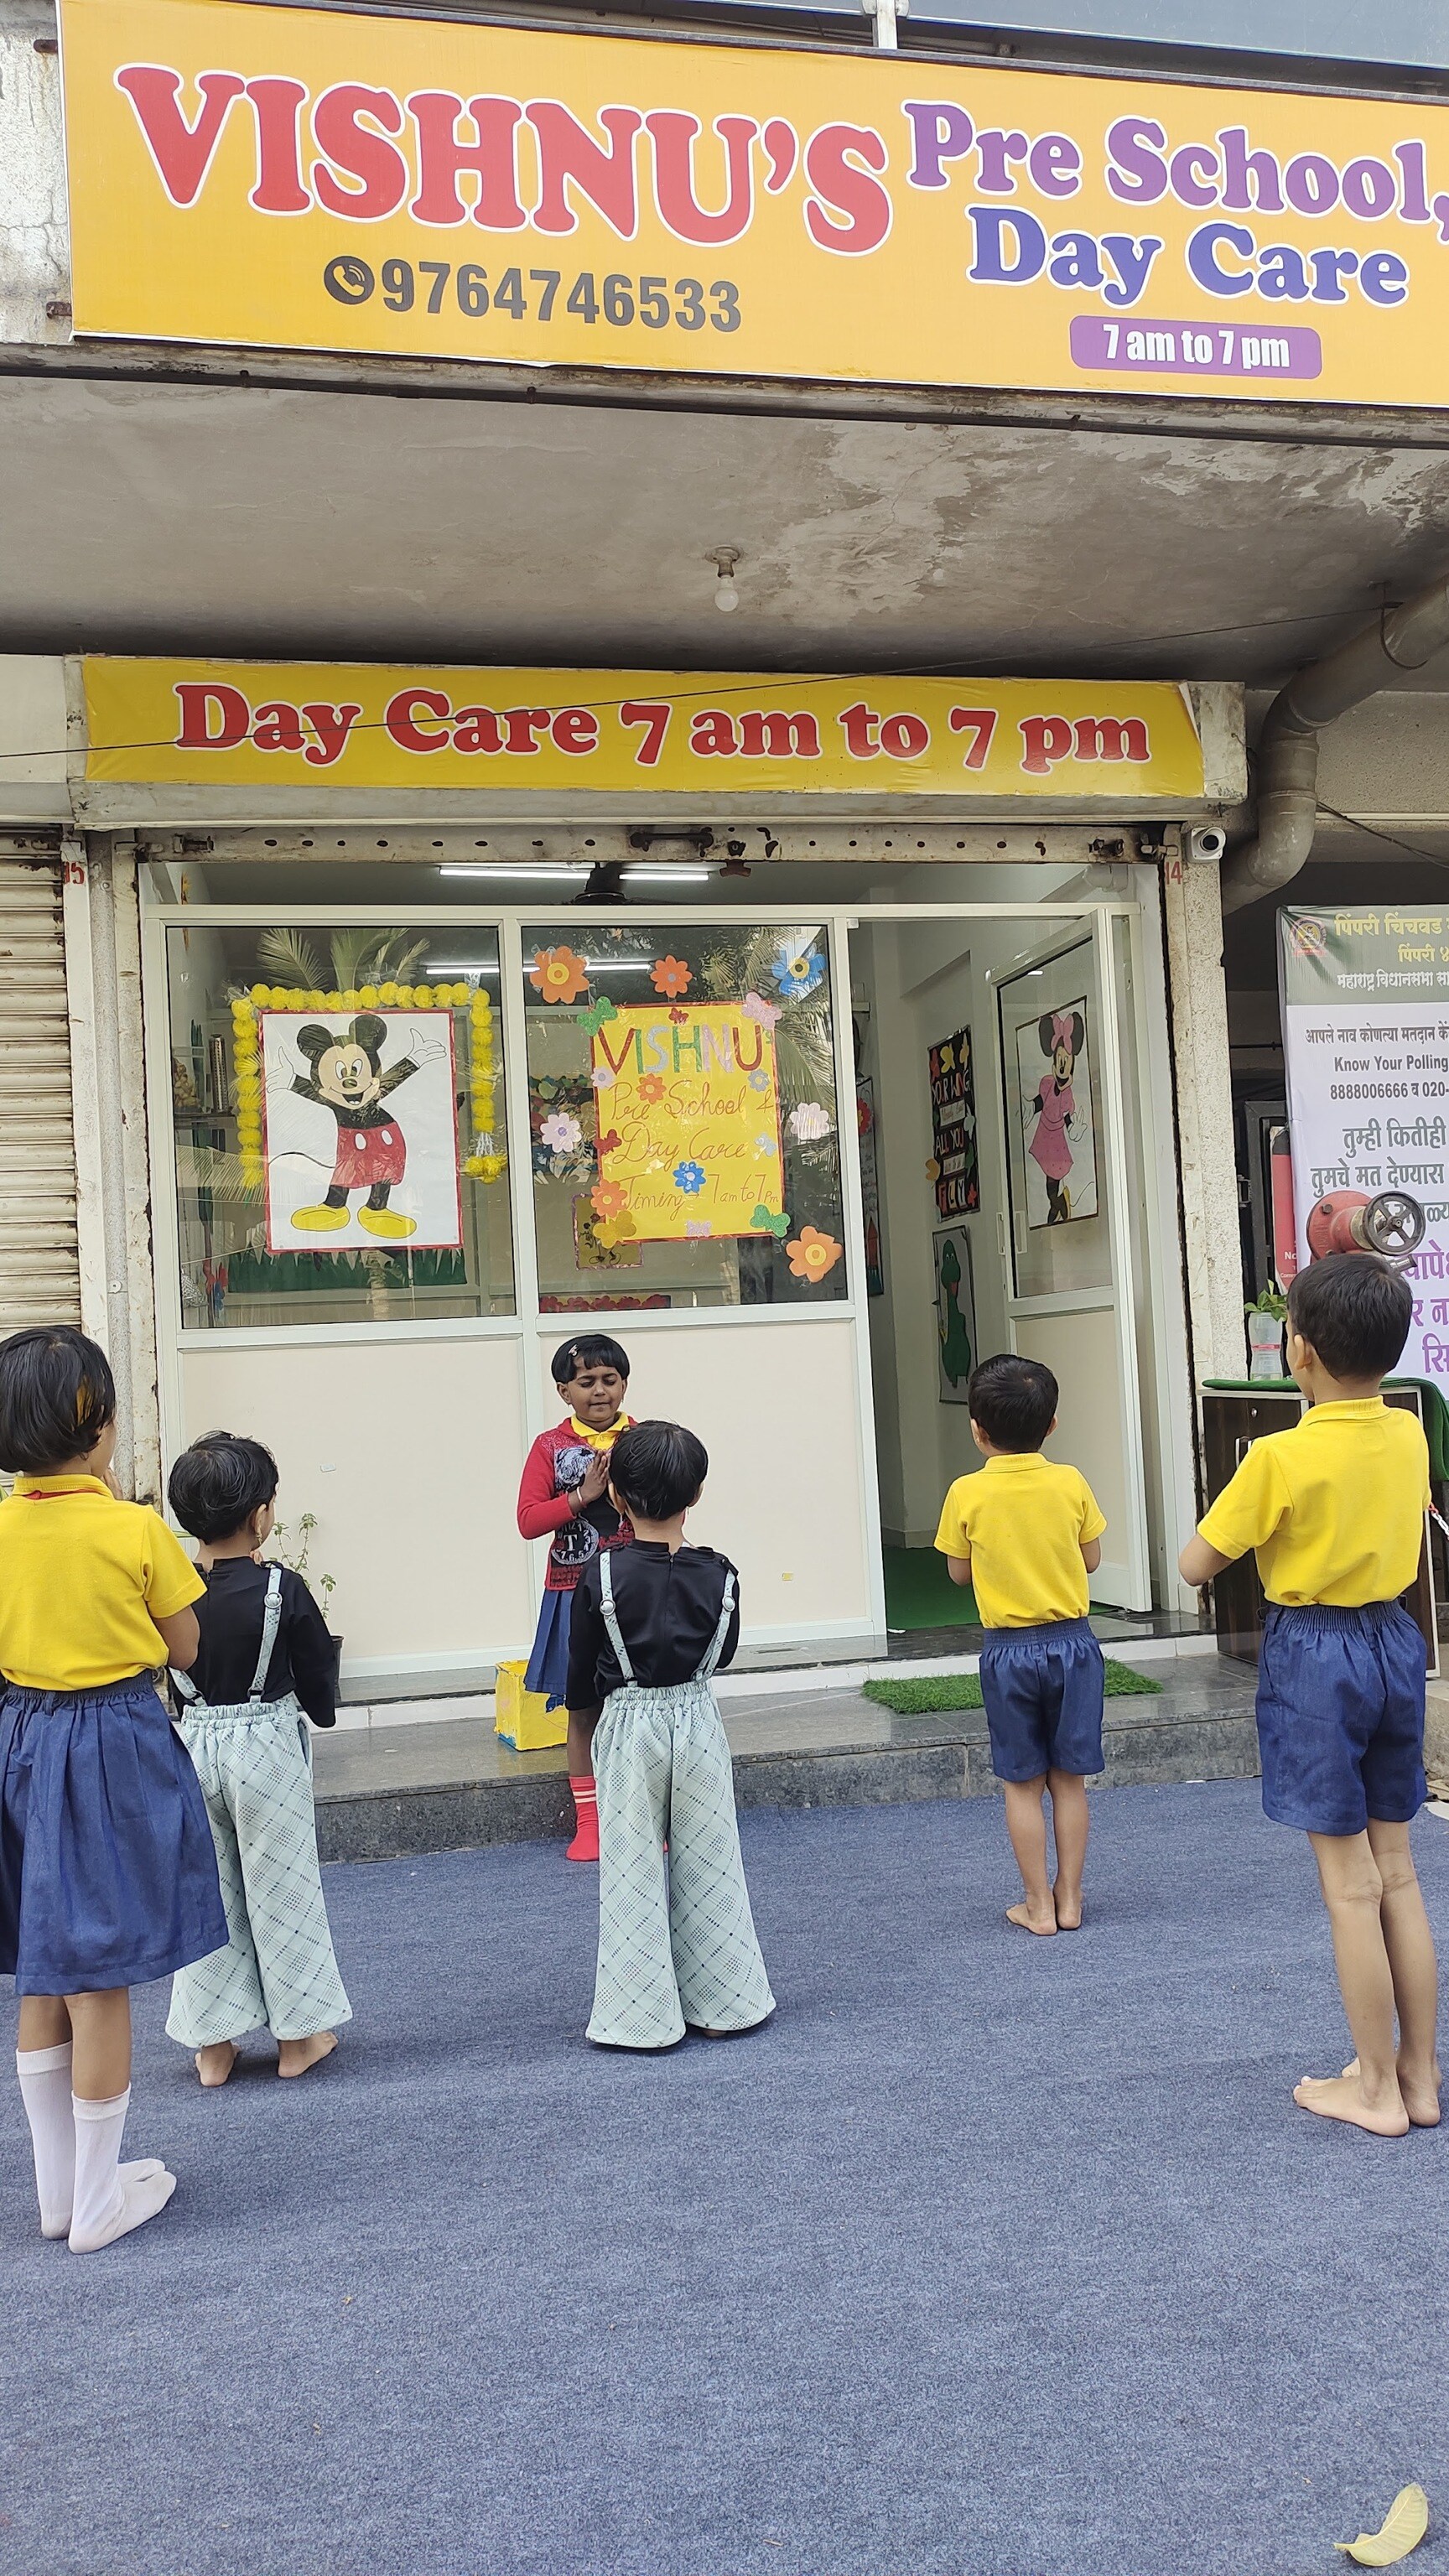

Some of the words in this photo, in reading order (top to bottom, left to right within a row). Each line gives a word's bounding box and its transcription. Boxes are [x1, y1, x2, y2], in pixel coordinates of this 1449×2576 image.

[115, 63, 892, 256] VISHNU'S
[901, 99, 1083, 199] Pre
[965, 205, 1162, 308] Day
[1186, 221, 1410, 307] Care
[382, 258, 741, 332] 9764746533
[1103, 325, 1119, 361] 7
[1126, 330, 1176, 362] am
[1182, 328, 1213, 364] to
[1218, 330, 1236, 365] 7
[1242, 336, 1291, 371] pm
[173, 682, 363, 766] Day
[384, 687, 599, 756] Care
[621, 703, 673, 766] 7
[689, 708, 823, 758] am
[839, 701, 930, 760] to
[948, 705, 999, 771] 7
[1017, 714, 1152, 774] pm
[64, 860, 85, 886] 15
[1165, 861, 1182, 885] 14
[1333, 912, 1380, 936] पिंपरी
[1384, 911, 1442, 935] चिंचवड
[1398, 943, 1435, 963] पिंपरी
[1376, 969, 1434, 988] विधानसभा
[1306, 1023, 1334, 1044] आपले
[1337, 1028, 1357, 1043] नाव
[1401, 1026, 1436, 1045] मतदान
[1334, 1056, 1370, 1072] Know
[1374, 1055, 1403, 1071] Your
[1407, 1054, 1449, 1072] Polling
[608, 1082, 650, 1120] Pre
[663, 1079, 747, 1119] School
[1330, 1082, 1409, 1100] 8888006666
[612, 1121, 680, 1171] Day
[688, 1127, 746, 1161] Care
[1342, 1117, 1382, 1158] तुम्ही
[1386, 1115, 1446, 1149] कितीही
[1310, 1158, 1350, 1198] तुमचे
[1355, 1166, 1382, 1187] मत
[1386, 1156, 1445, 1188] देण्यास
